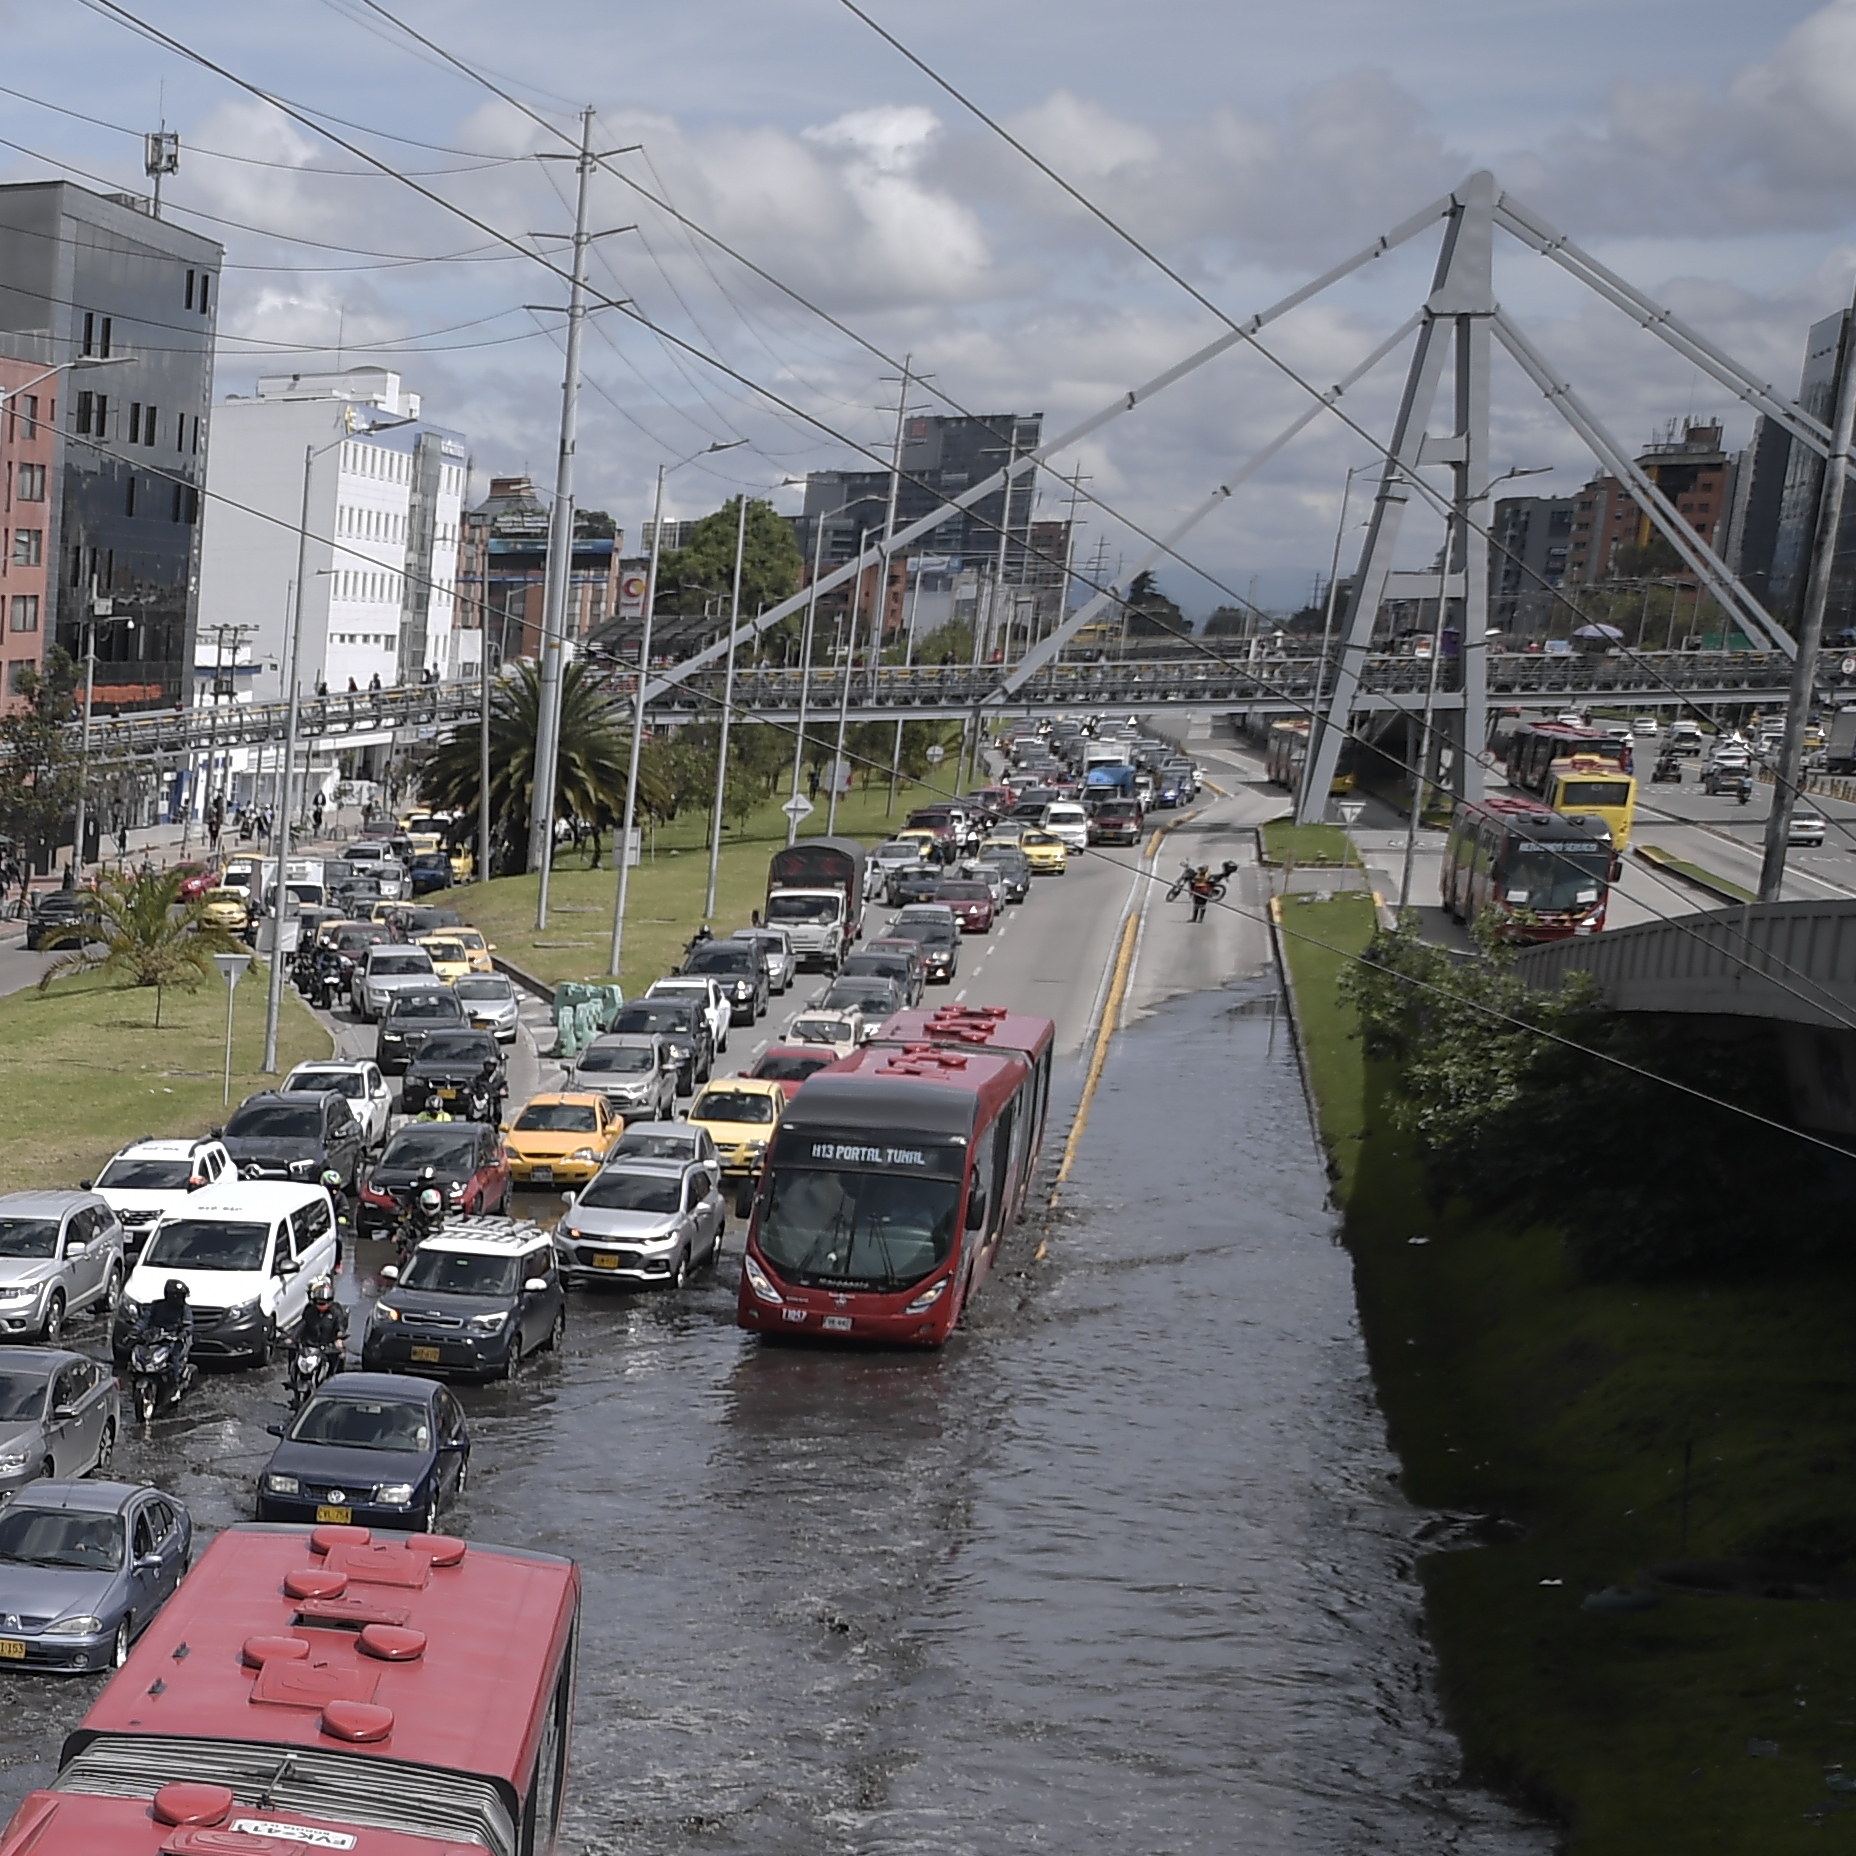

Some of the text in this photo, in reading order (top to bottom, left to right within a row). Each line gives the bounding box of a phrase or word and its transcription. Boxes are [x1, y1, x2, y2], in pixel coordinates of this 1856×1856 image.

[811, 1143, 926, 1166] H13 PORTAL TUNAL
